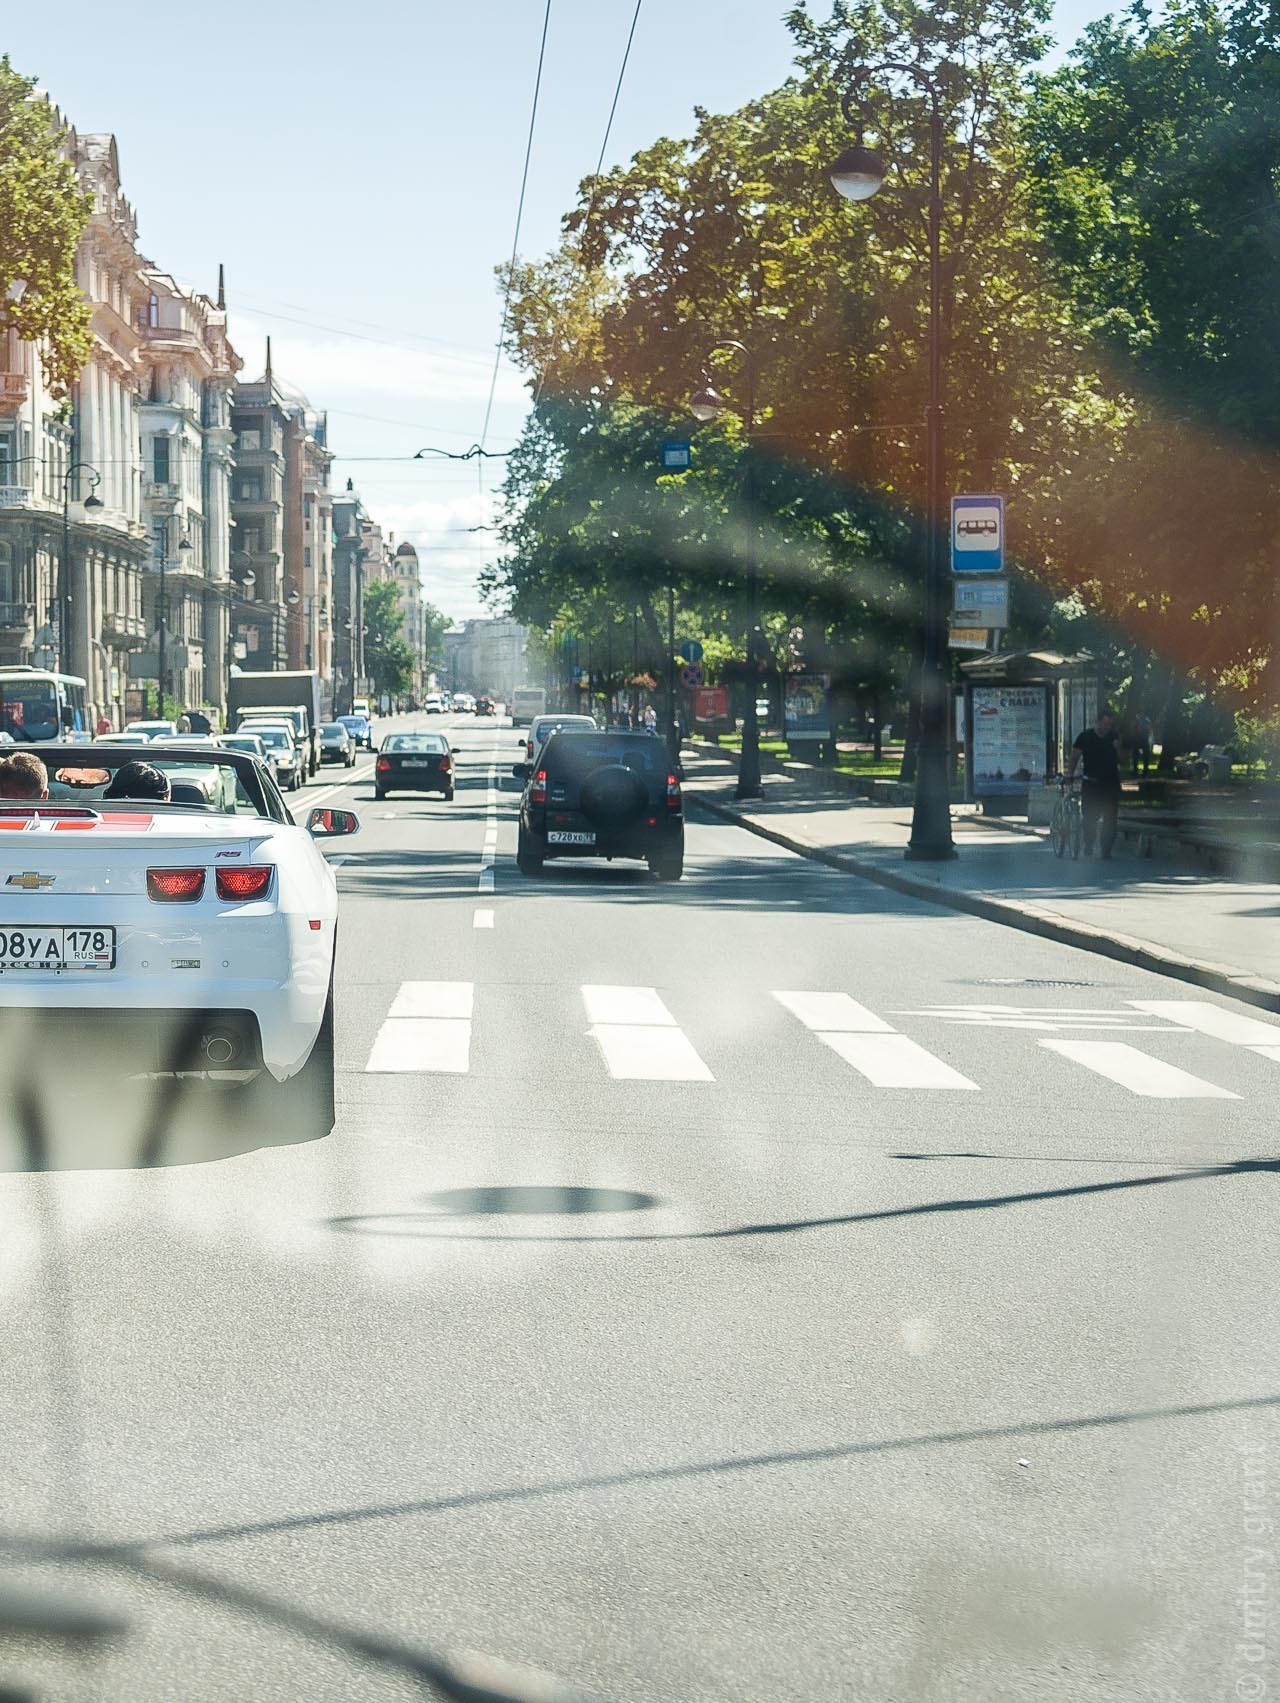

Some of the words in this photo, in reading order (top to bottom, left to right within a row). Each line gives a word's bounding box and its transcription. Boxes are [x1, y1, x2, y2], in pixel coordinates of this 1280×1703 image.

[214, 850, 242, 858] RS
[67, 931, 105, 951] 178
[74, 952, 94, 960] RUS
